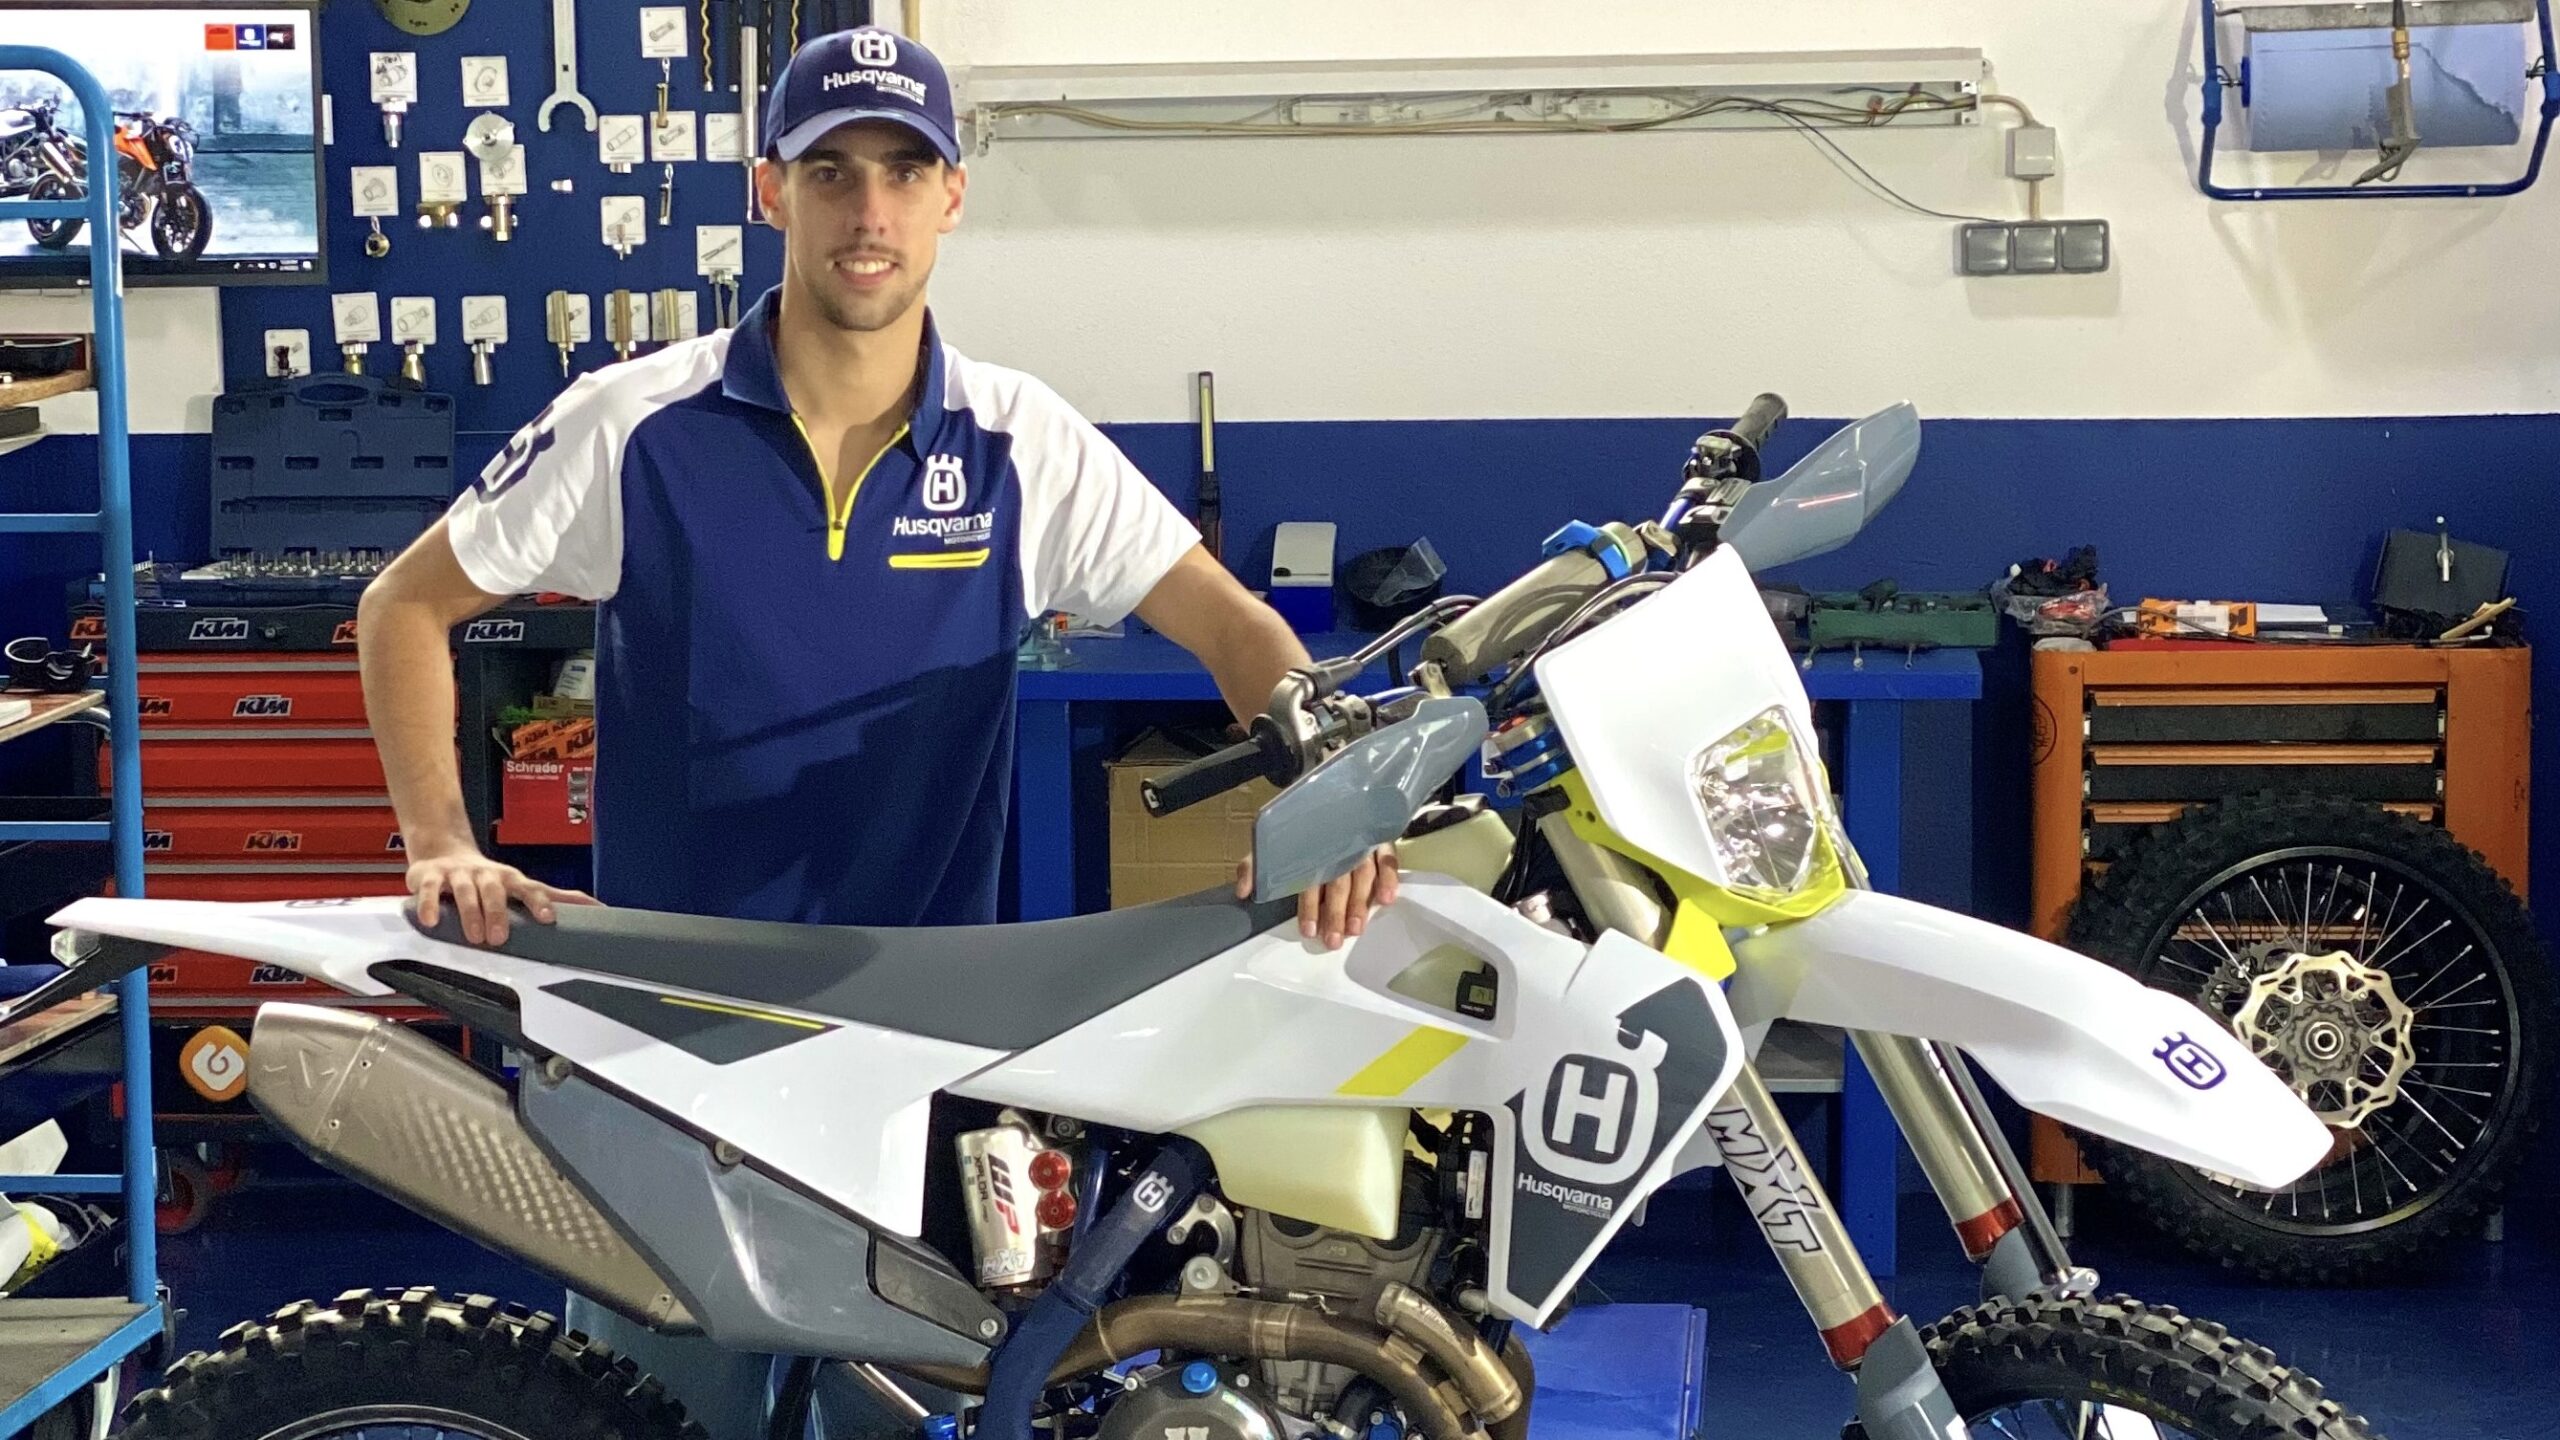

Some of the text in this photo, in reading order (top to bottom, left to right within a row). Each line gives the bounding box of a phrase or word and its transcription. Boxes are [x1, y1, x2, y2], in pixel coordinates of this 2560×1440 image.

[823, 69, 926, 97] Husqvarna
[892, 512, 993, 538] Husqvarna
[191, 619, 247, 638] KTM
[467, 620, 522, 640] KTM
[234, 696, 291, 715] KTM
[506, 761, 564, 774] Schrader
[246, 832, 300, 850] KTM
[1706, 1107, 1822, 1253] MXT
[1518, 1172, 1613, 1211] Husqvarna
